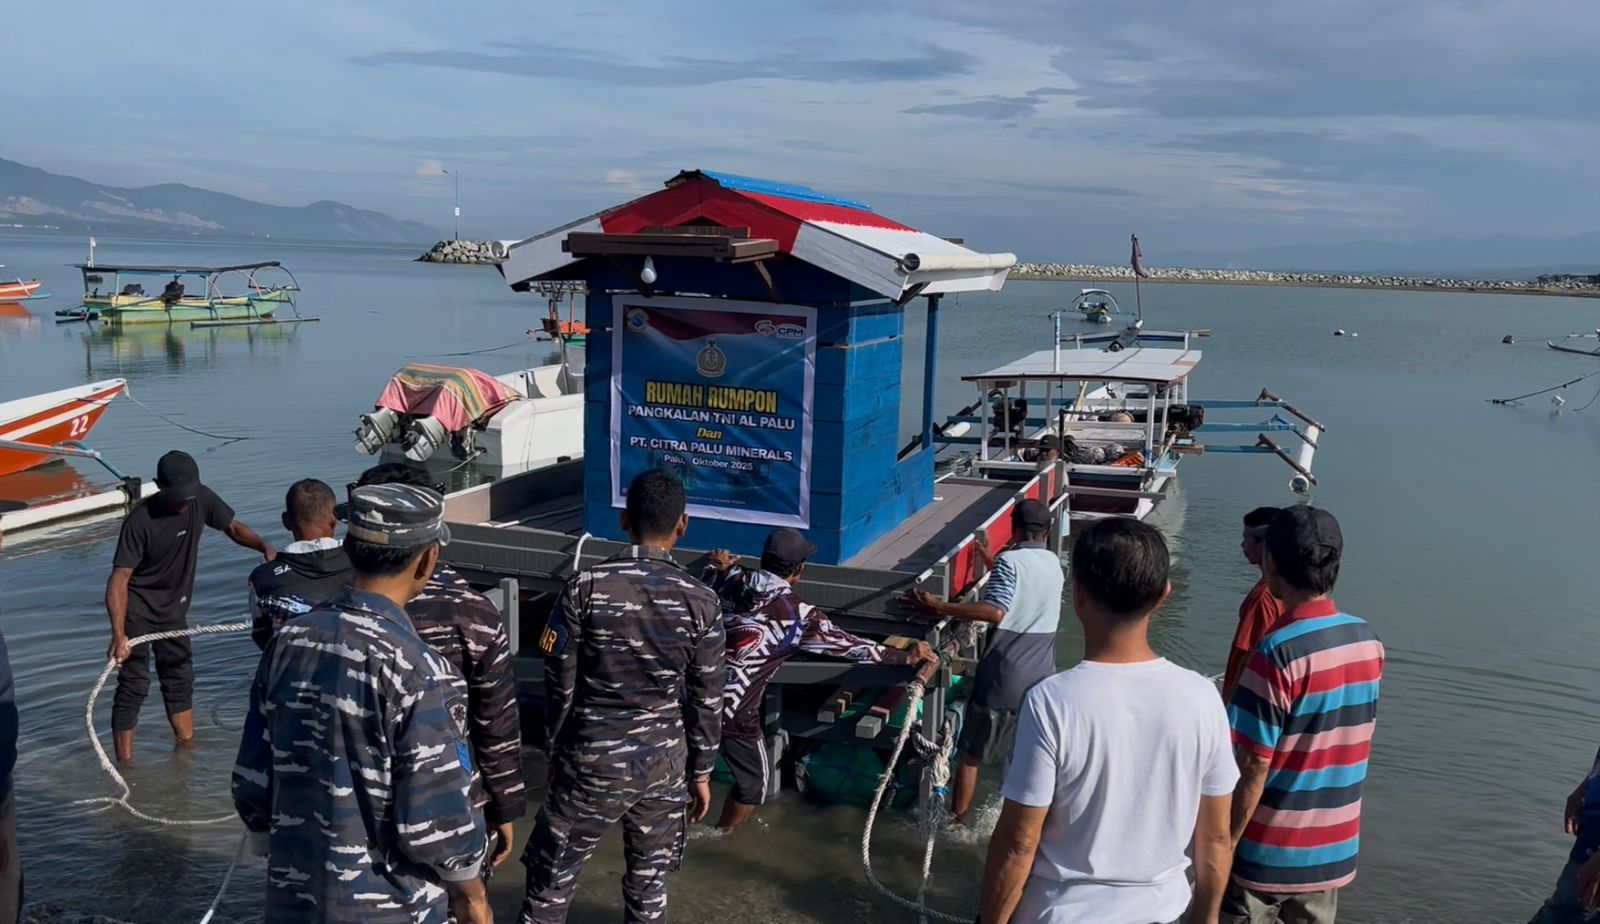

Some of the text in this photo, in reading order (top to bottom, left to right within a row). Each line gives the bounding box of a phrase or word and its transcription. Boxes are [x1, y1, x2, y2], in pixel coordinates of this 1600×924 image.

[778, 327, 804, 336] CPM
[646, 381, 777, 413] RUMAH RUMPON
[70, 415, 89, 437] 22
[628, 405, 796, 430] PANGKALAN TNI AL PALU
[696, 427, 722, 439] Dan
[630, 436, 793, 461] PT. CITRA PALU MINERALS
[692, 457, 729, 468] Oktober
[731, 461, 753, 470] 2025
